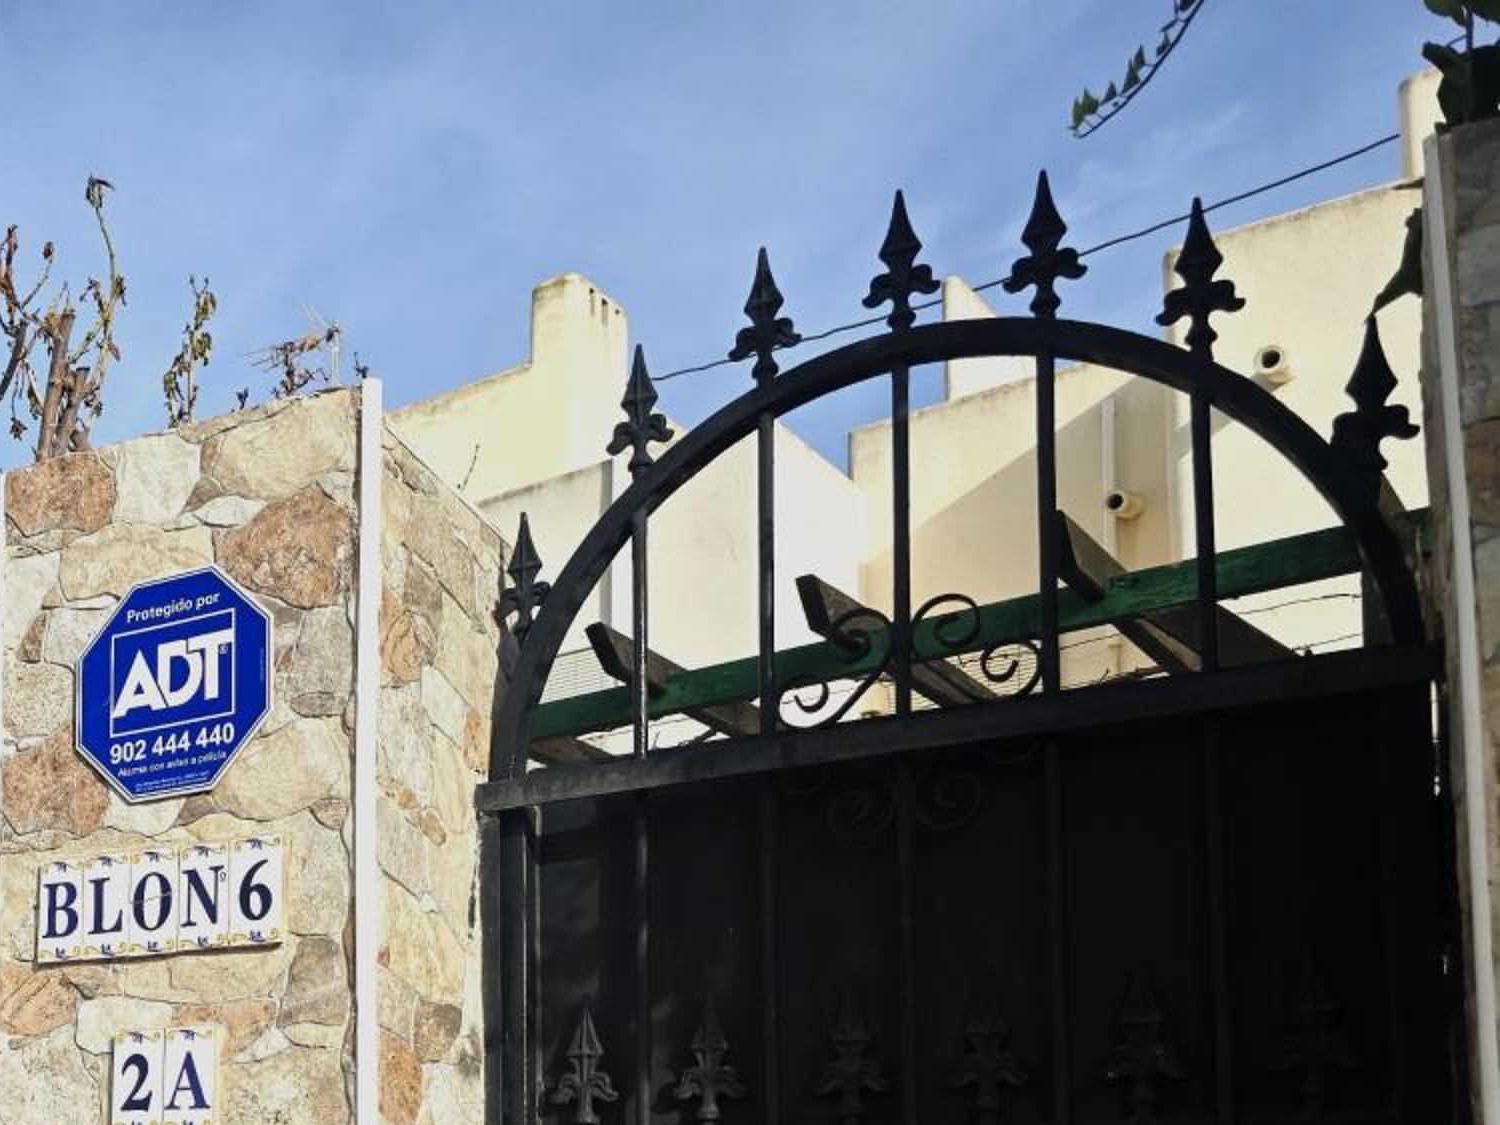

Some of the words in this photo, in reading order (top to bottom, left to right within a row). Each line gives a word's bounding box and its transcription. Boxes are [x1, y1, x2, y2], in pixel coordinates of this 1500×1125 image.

[127, 597, 193, 623] Protegido
[195, 592, 220, 610] por
[112, 628, 234, 719] ADT
[110, 740, 147, 764] 902
[152, 731, 190, 757] 444
[196, 723, 235, 748] 440
[120, 1051, 210, 1111] 2A
